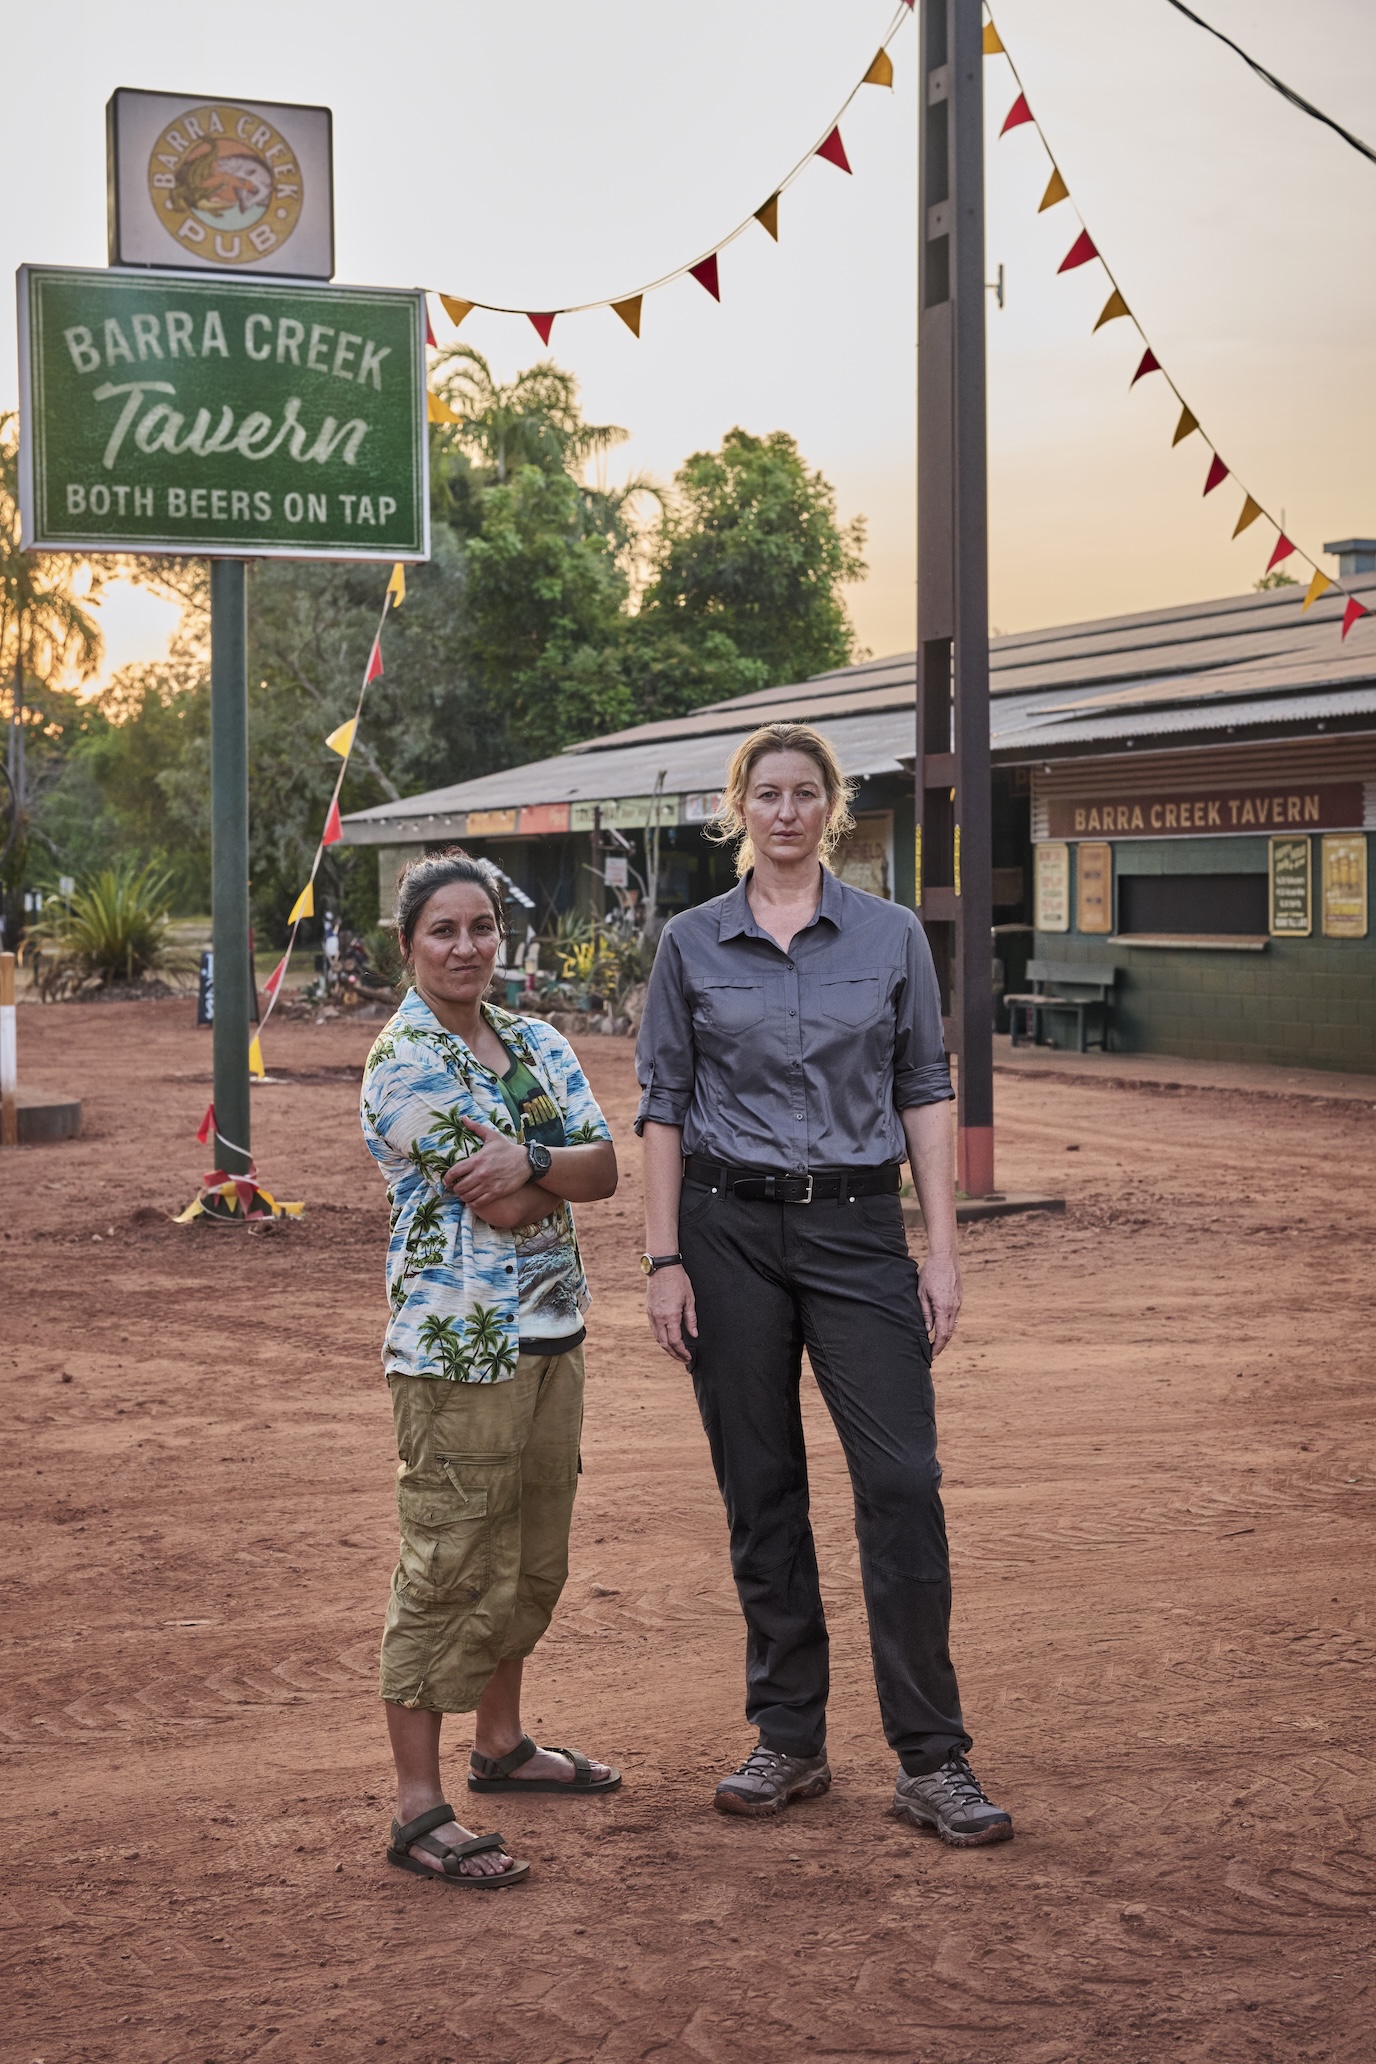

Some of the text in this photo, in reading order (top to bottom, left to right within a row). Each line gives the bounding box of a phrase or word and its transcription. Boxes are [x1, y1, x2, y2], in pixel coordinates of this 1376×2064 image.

[152, 109, 299, 201] BARRA CREEK
[177, 217, 279, 259] PUB
[62, 310, 393, 391] BARRA CREEK
[92, 380, 370, 471] Tavern
[67, 484, 398, 526] BOTH BEERS ON TAP
[1074, 795, 1321, 832] BARRA CREEK TAVERN
